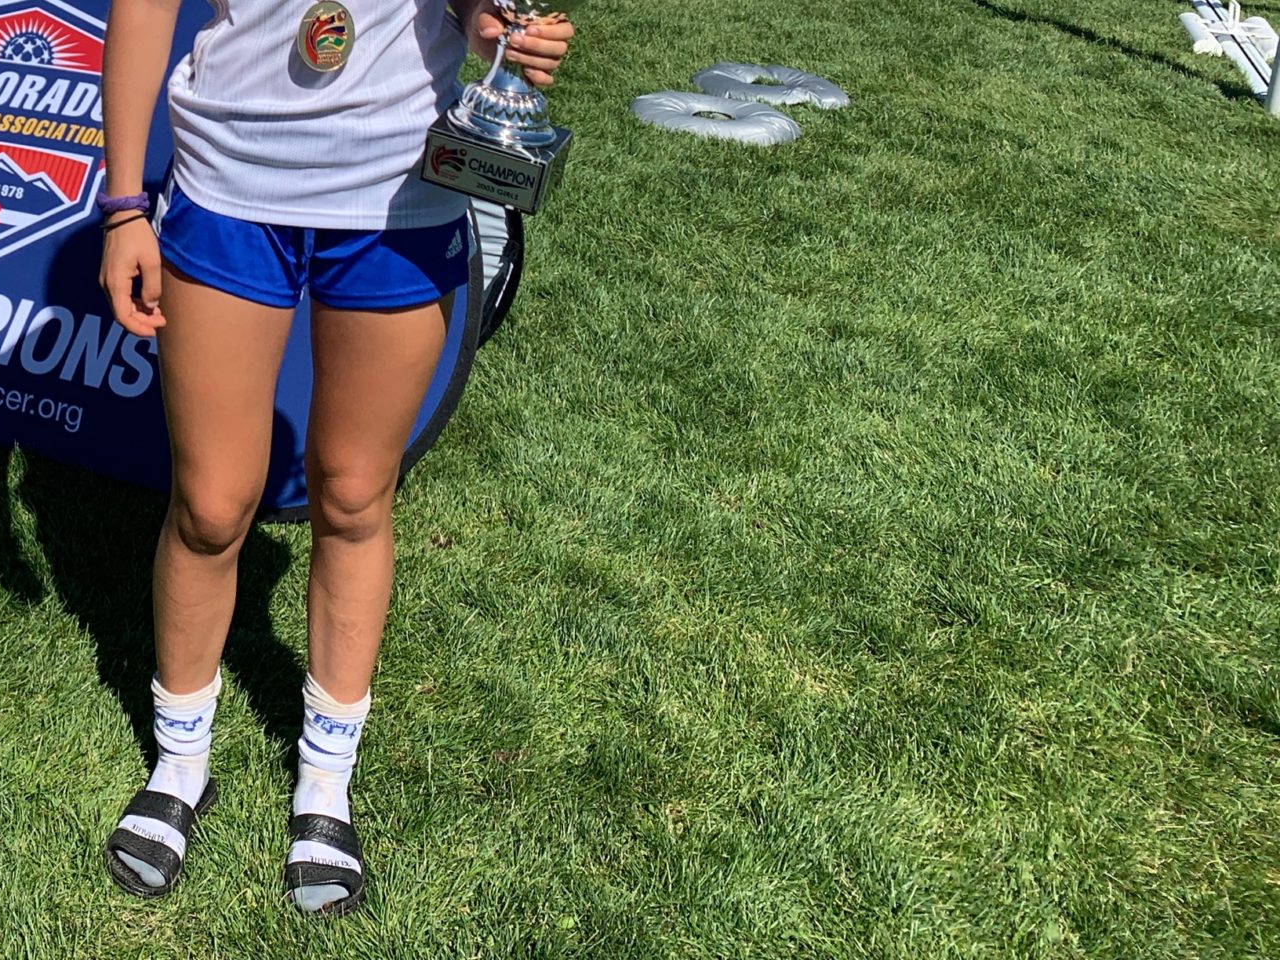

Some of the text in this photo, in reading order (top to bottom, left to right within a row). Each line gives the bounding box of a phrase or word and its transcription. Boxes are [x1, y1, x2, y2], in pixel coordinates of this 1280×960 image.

[468, 157, 536, 189] CHAMPION
[476, 182, 519, 200] 2003 GIRLS
